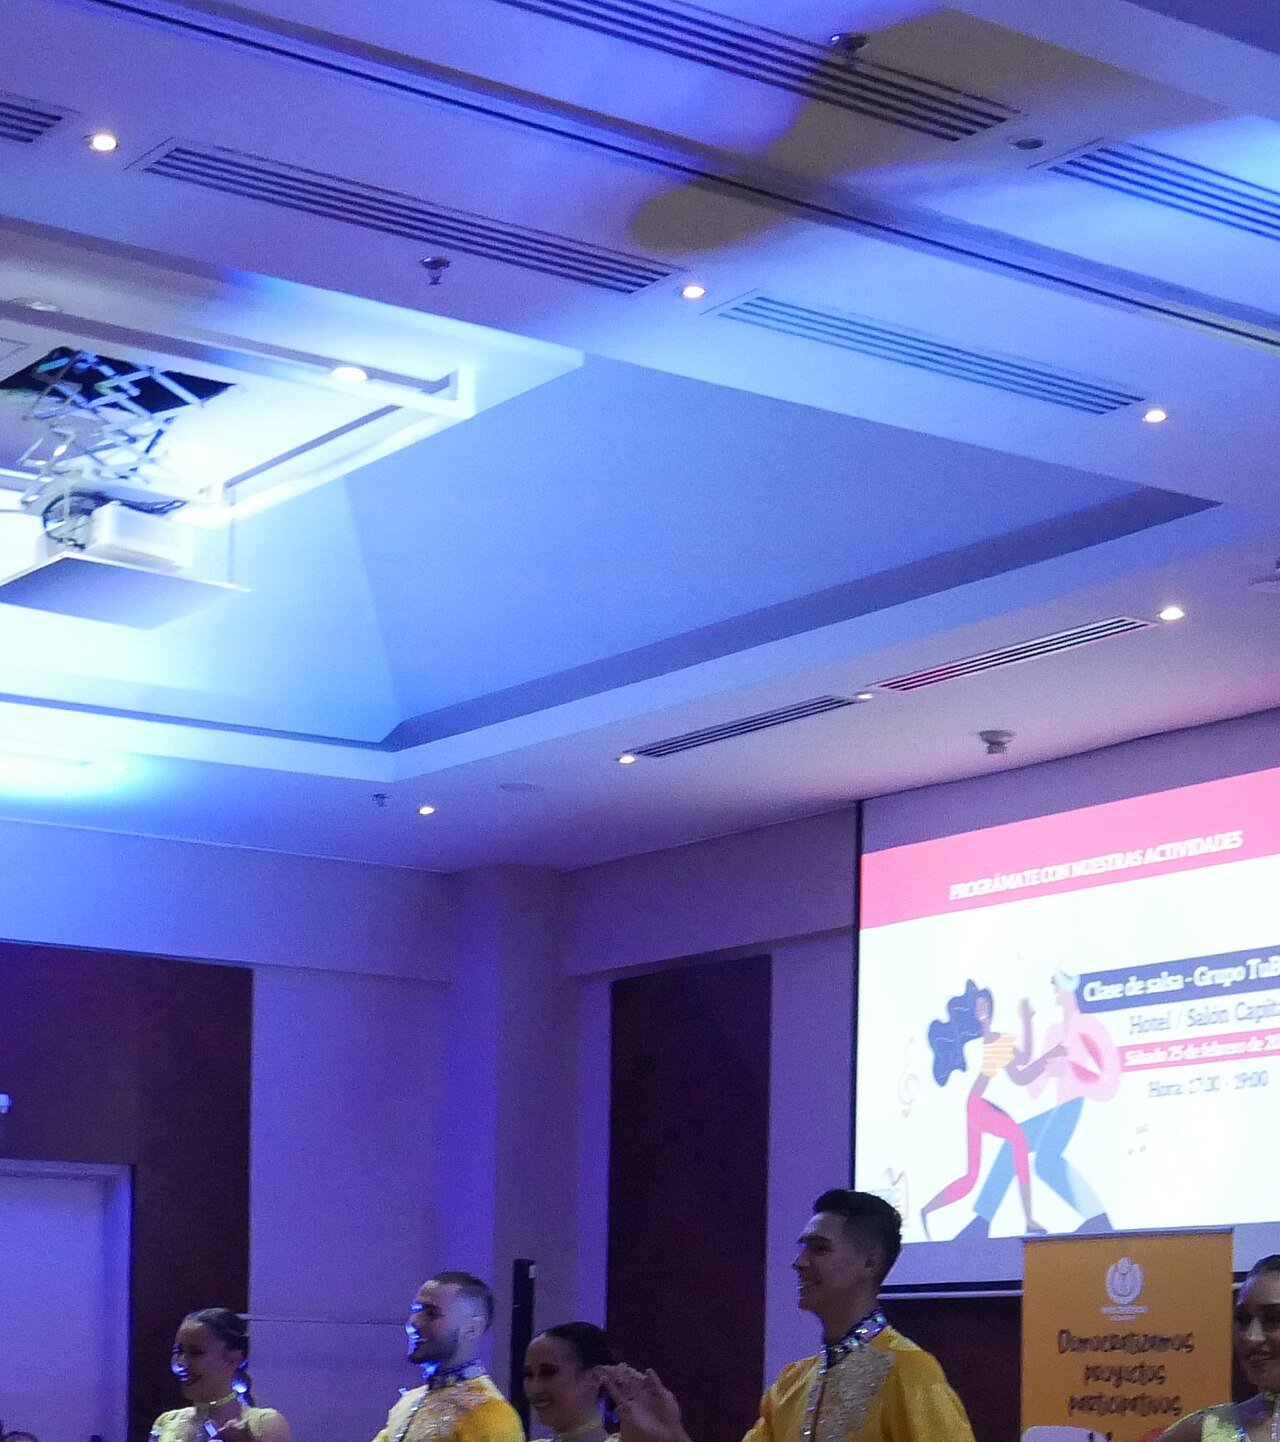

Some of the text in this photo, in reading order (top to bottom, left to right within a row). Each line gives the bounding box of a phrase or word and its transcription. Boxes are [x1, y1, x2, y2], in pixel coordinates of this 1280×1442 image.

[1083, 980, 1123, 1002] Clase
[1192, 966, 1246, 988] Grupo
[1129, 1011, 1171, 1035] Hotel
[1187, 1005, 1229, 1027] Salón
